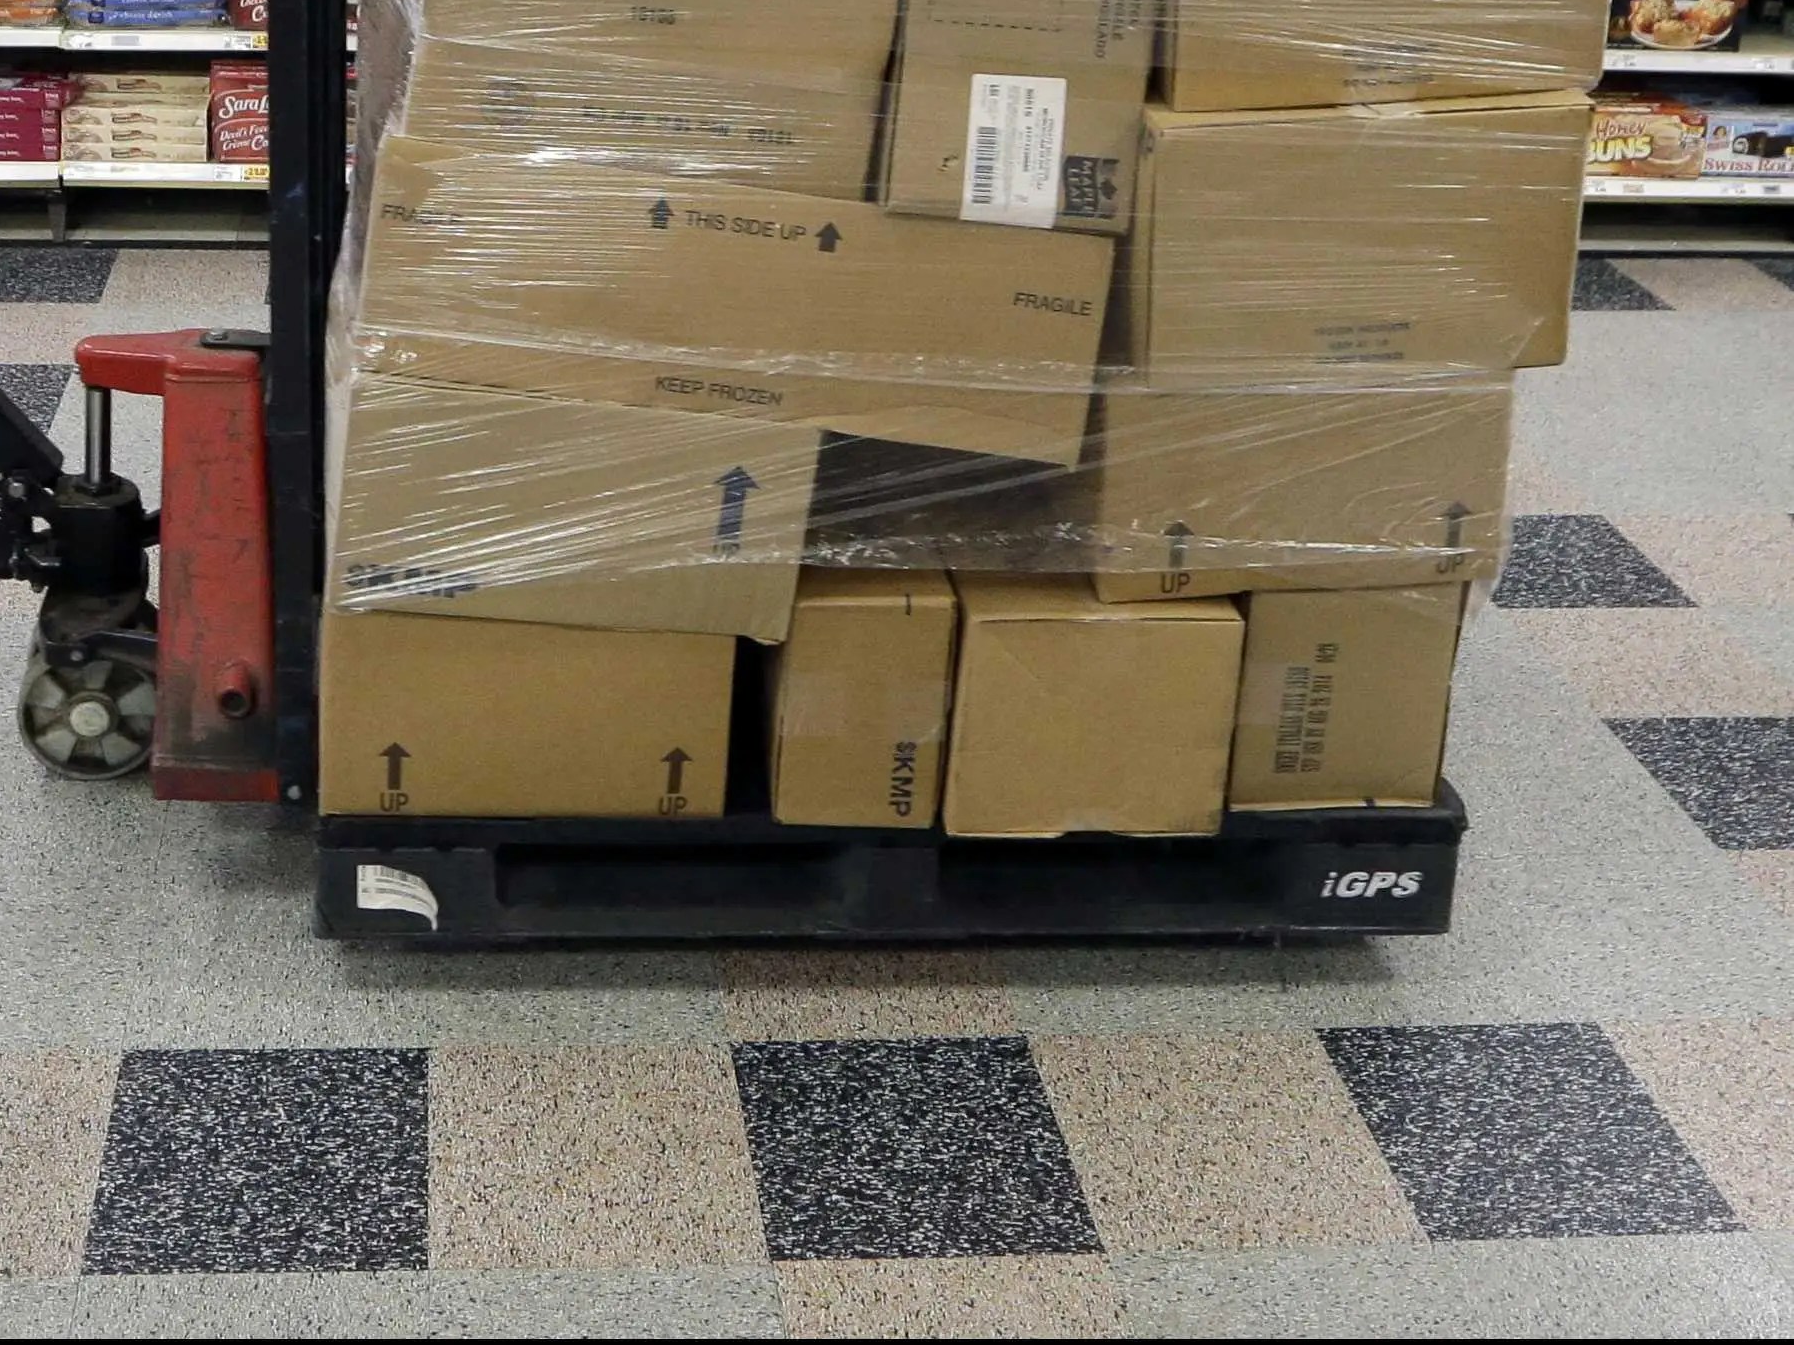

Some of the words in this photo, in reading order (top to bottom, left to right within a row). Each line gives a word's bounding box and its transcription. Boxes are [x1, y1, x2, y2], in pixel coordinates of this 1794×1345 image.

[1596, 120, 1646, 140] Honey
[1703, 157, 1754, 172] SWISS
[1068, 167, 1080, 203] LEAF
[1081, 159, 1095, 215] MAPLE
[685, 208, 726, 232] THIS
[731, 215, 775, 237] SIDE
[779, 222, 807, 242] UP
[1013, 290, 1093, 318] FRAGILE
[655, 374, 705, 397] KEEP
[708, 381, 784, 407] FROZEN
[1436, 552, 1465, 575] UP
[1160, 572, 1191, 595] UP
[887, 741, 917, 818] SKMP
[378, 791, 409, 813] UP
[658, 795, 688, 818] UP
[1319, 870, 1425, 899] iGPS
